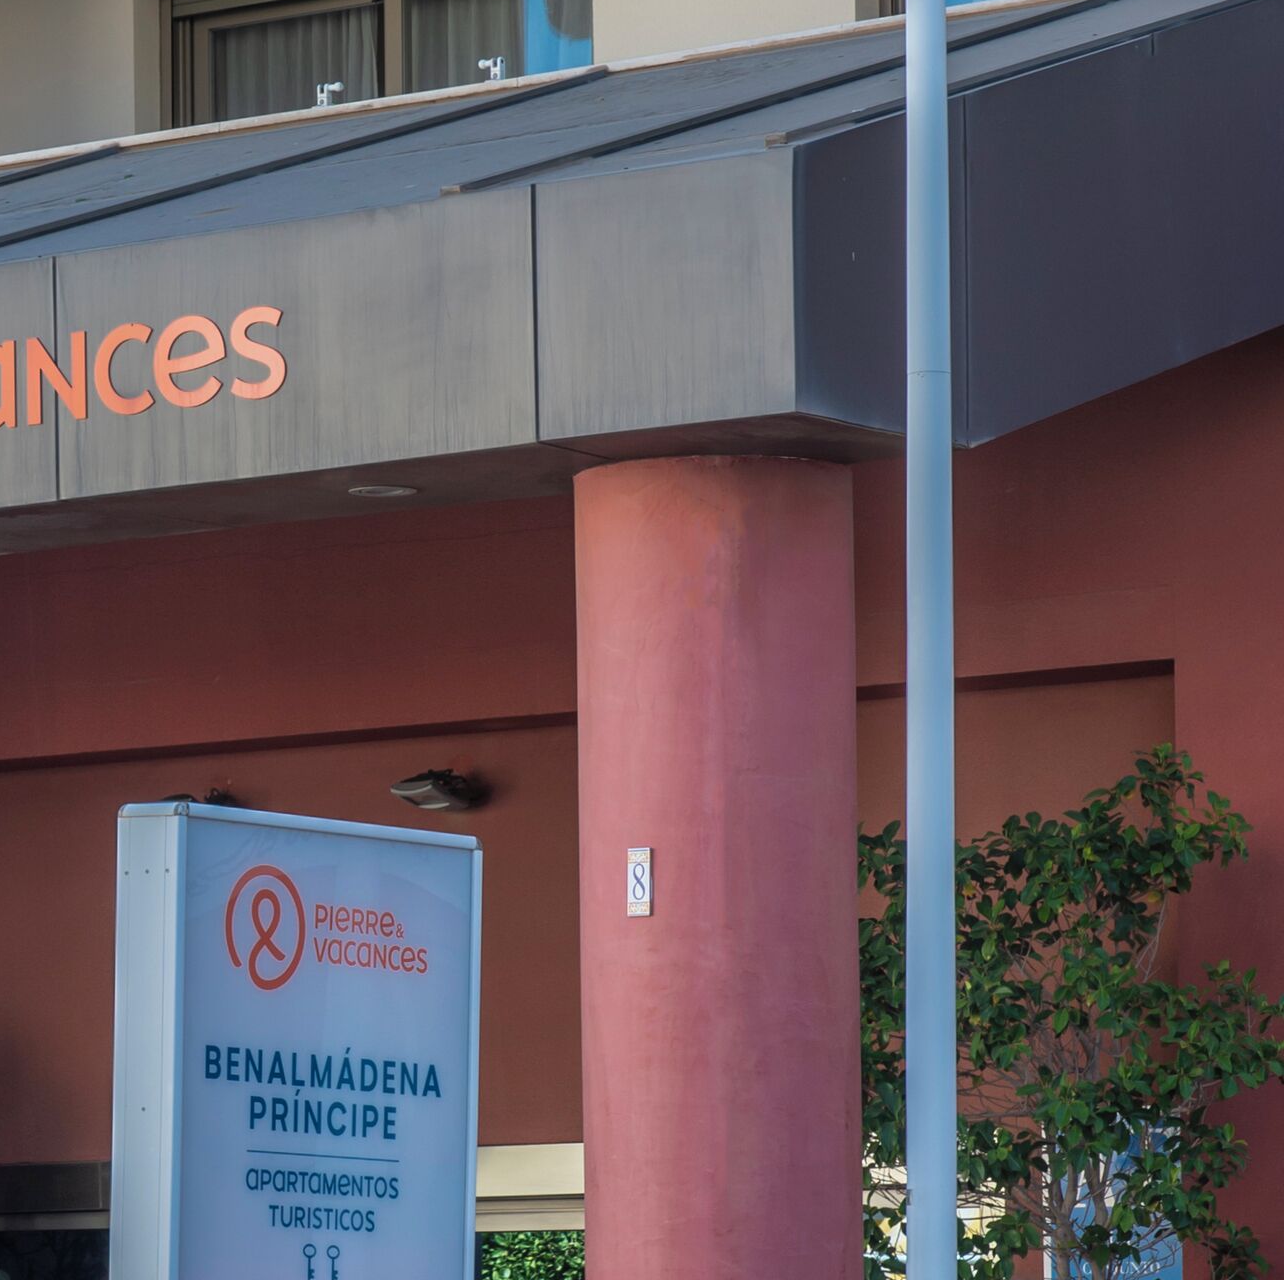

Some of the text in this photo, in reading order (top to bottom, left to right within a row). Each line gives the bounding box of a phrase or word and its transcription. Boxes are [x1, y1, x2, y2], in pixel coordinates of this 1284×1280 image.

[632, 862, 646, 901] 8
[204, 1045, 442, 1099] BENALMÁDENA
[248, 1088, 398, 1141] PRÍNCIPE
[268, 1204, 376, 1233] TURISTICOS
